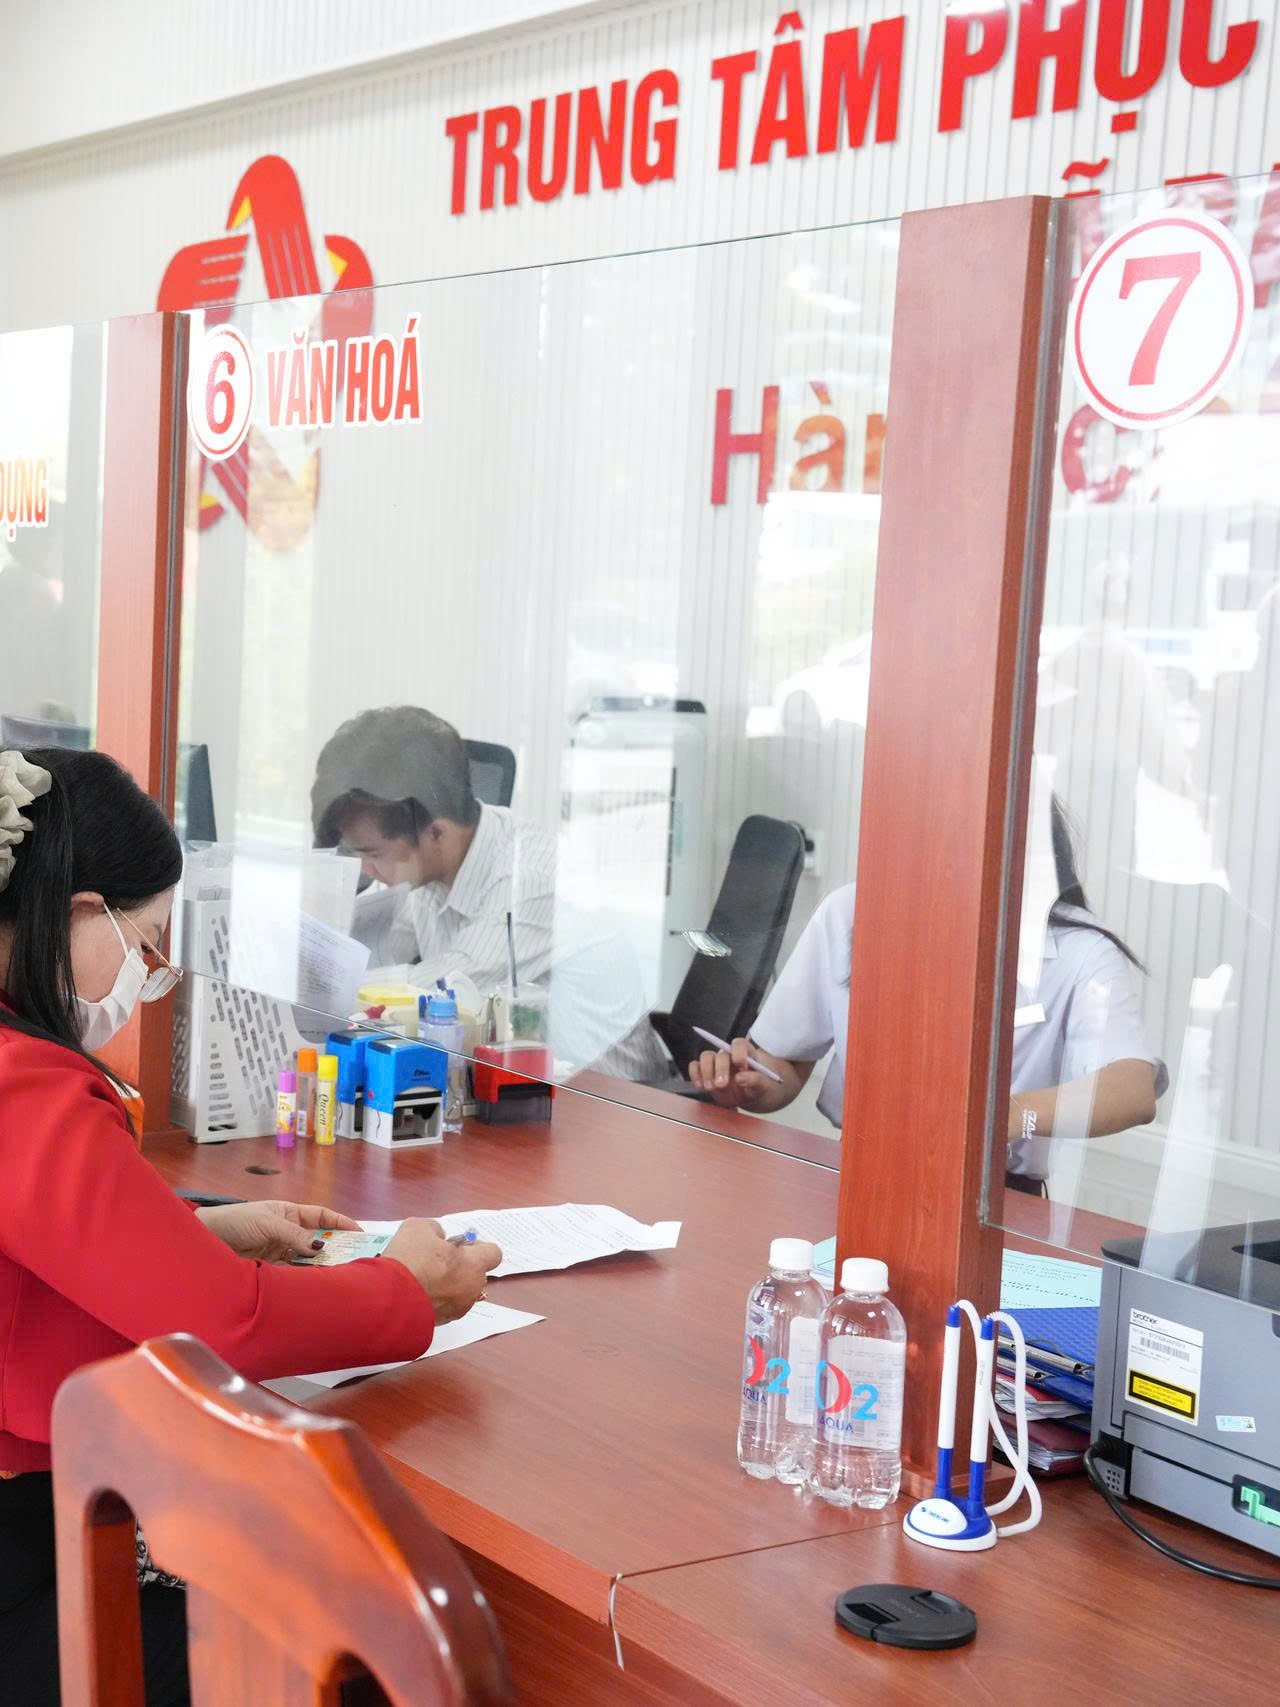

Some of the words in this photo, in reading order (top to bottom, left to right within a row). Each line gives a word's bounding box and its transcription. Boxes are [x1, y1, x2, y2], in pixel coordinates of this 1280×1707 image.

[444, 68, 681, 217] TRUNG
[711, 10, 907, 172] TÂM
[936, 0, 1260, 135] PHỤC
[205, 350, 236, 435] 6
[267, 328, 336, 428] VĂN
[345, 317, 420, 423] HOÁ
[1119, 251, 1201, 386] 7
[318, 1093, 330, 1126] Queen
